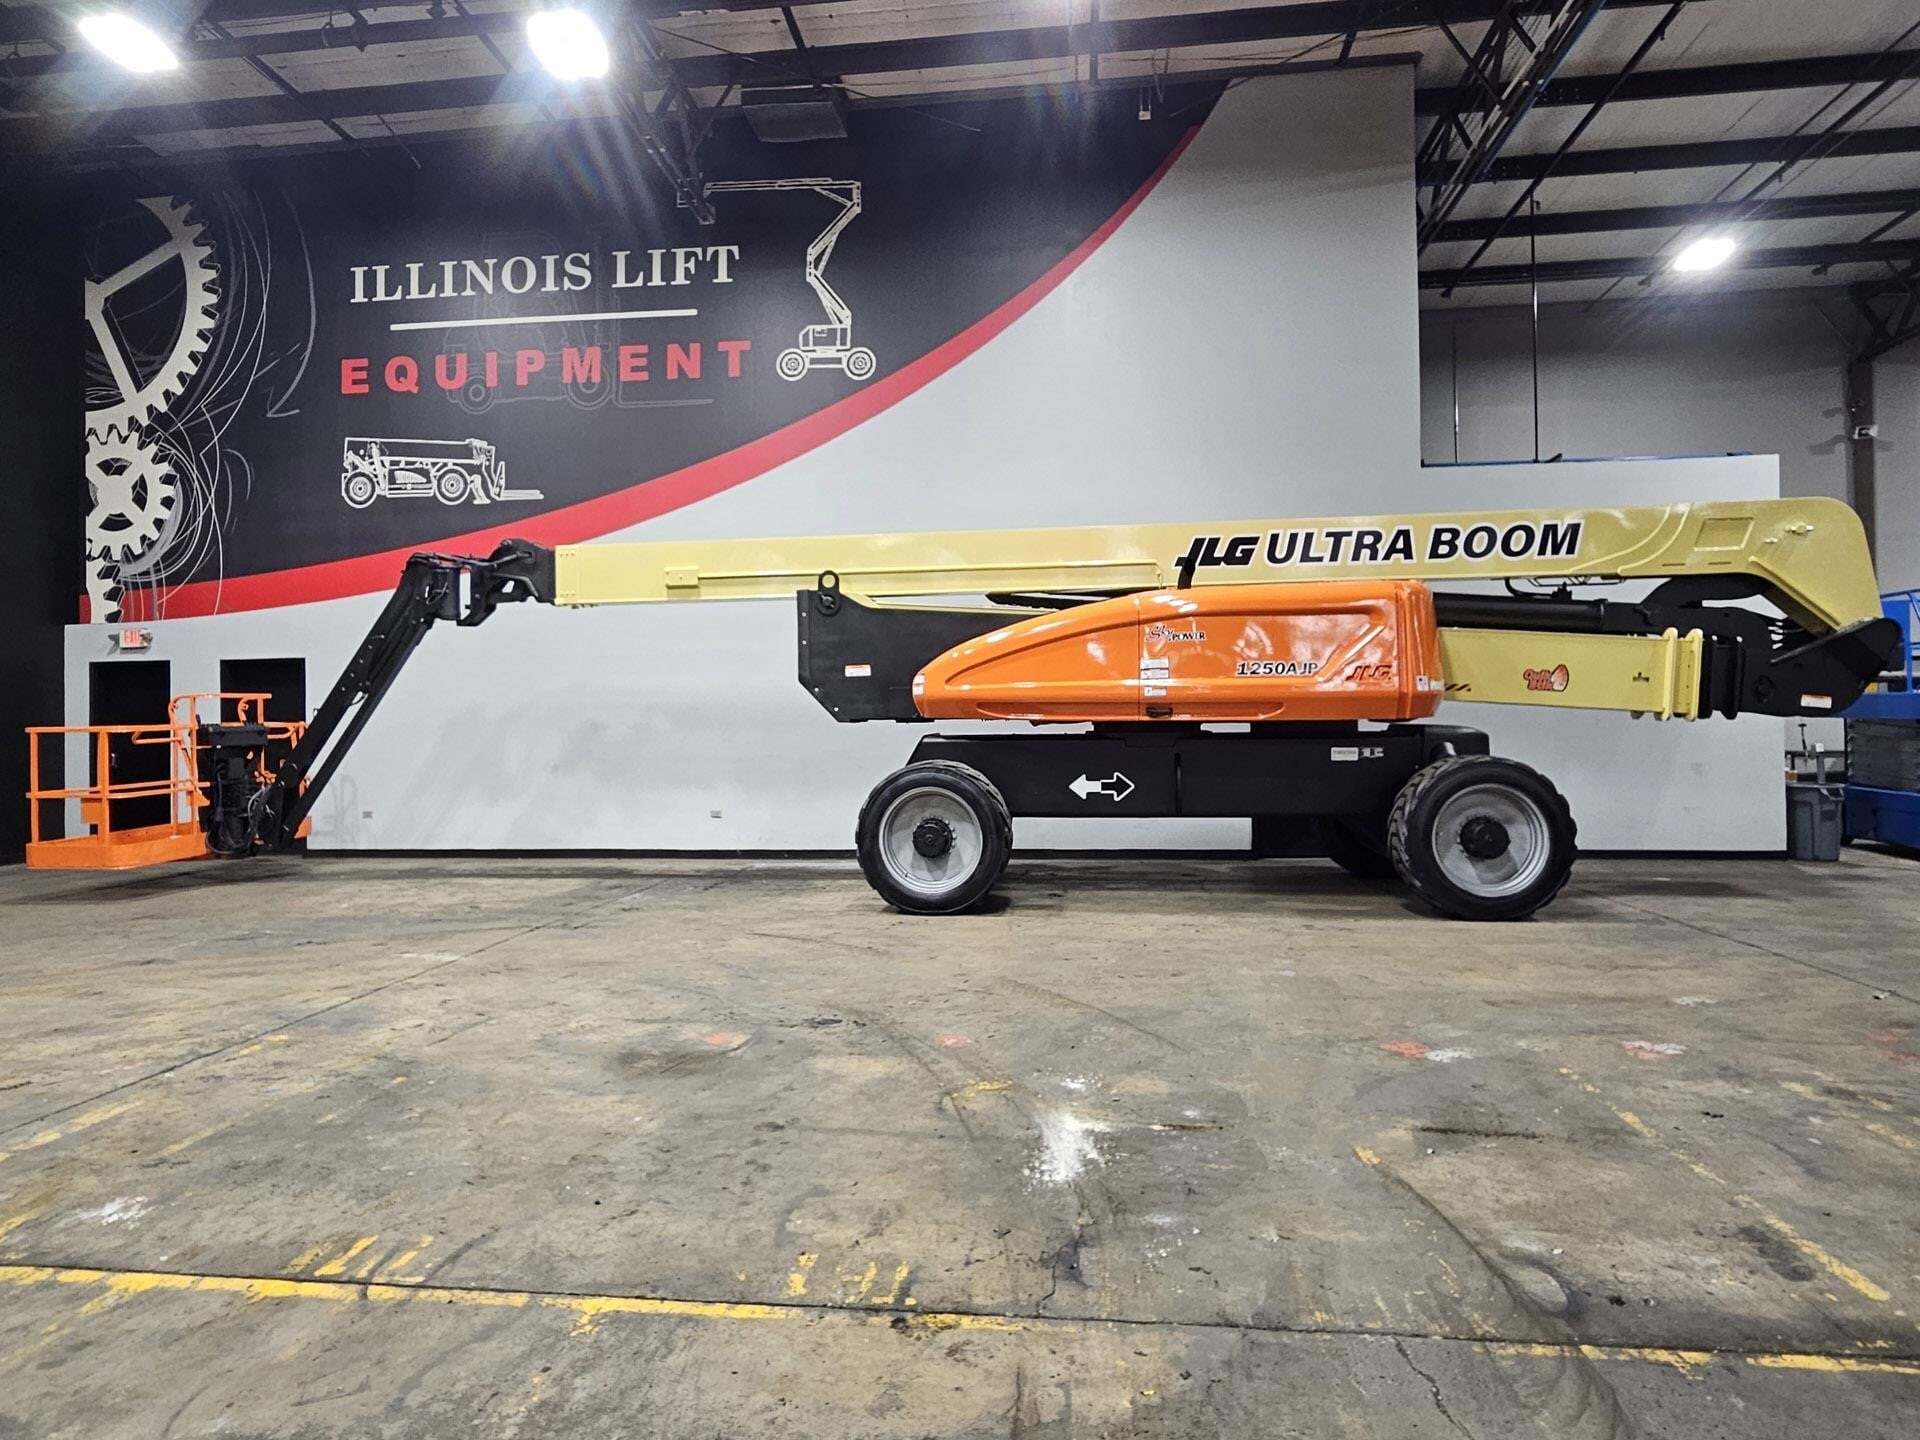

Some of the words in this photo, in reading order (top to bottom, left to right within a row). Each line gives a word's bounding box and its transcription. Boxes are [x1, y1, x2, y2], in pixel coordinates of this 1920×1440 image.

[350, 251, 592, 303] ILLINOIS
[611, 245, 740, 288] LIFT
[340, 340, 751, 395] EQUIPMENT
[1174, 536, 1260, 566] JLG
[1266, 529, 1415, 565] ULTRA
[1427, 523, 1582, 559] BOOM
[1236, 662, 1318, 676] 1250AJP
